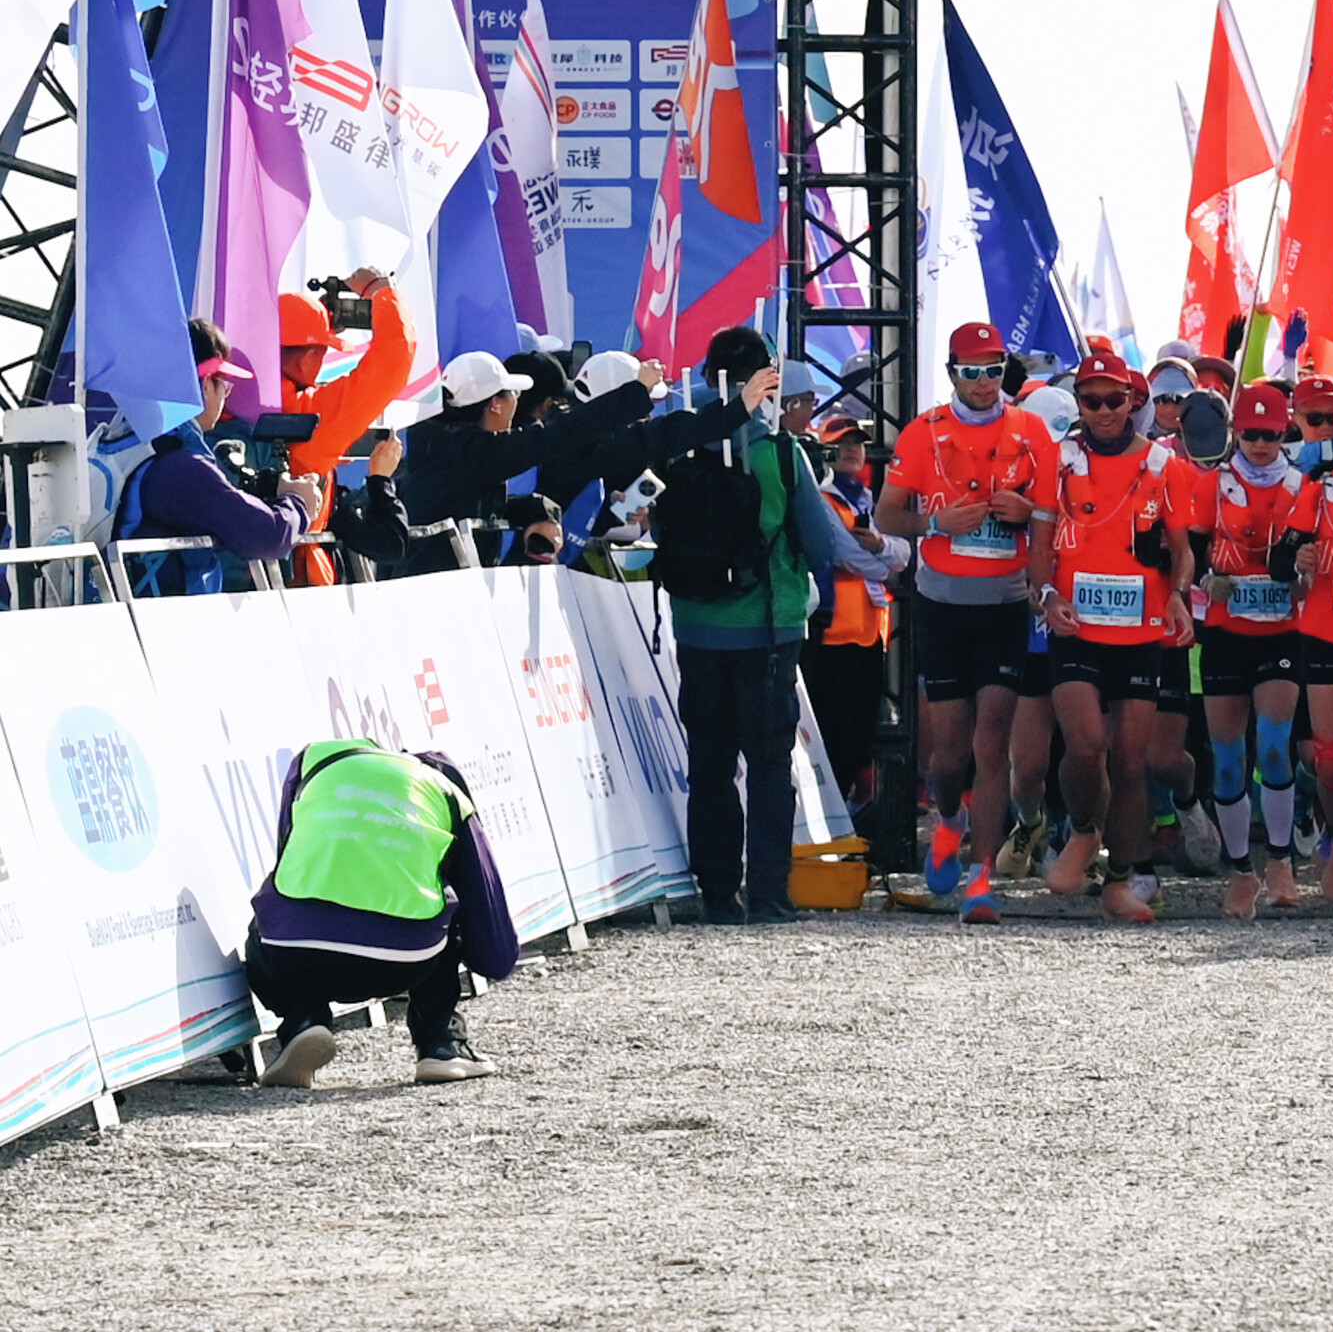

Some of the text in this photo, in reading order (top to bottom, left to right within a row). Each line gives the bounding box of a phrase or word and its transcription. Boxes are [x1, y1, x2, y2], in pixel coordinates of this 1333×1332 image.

[581, 101, 617, 111] 正大食品
[581, 111, 617, 119] CP FOOD
[1078, 587, 1138, 608] 01S 1037
[1233, 586, 1257, 603] 01S
[616, 660, 690, 795] vivo
